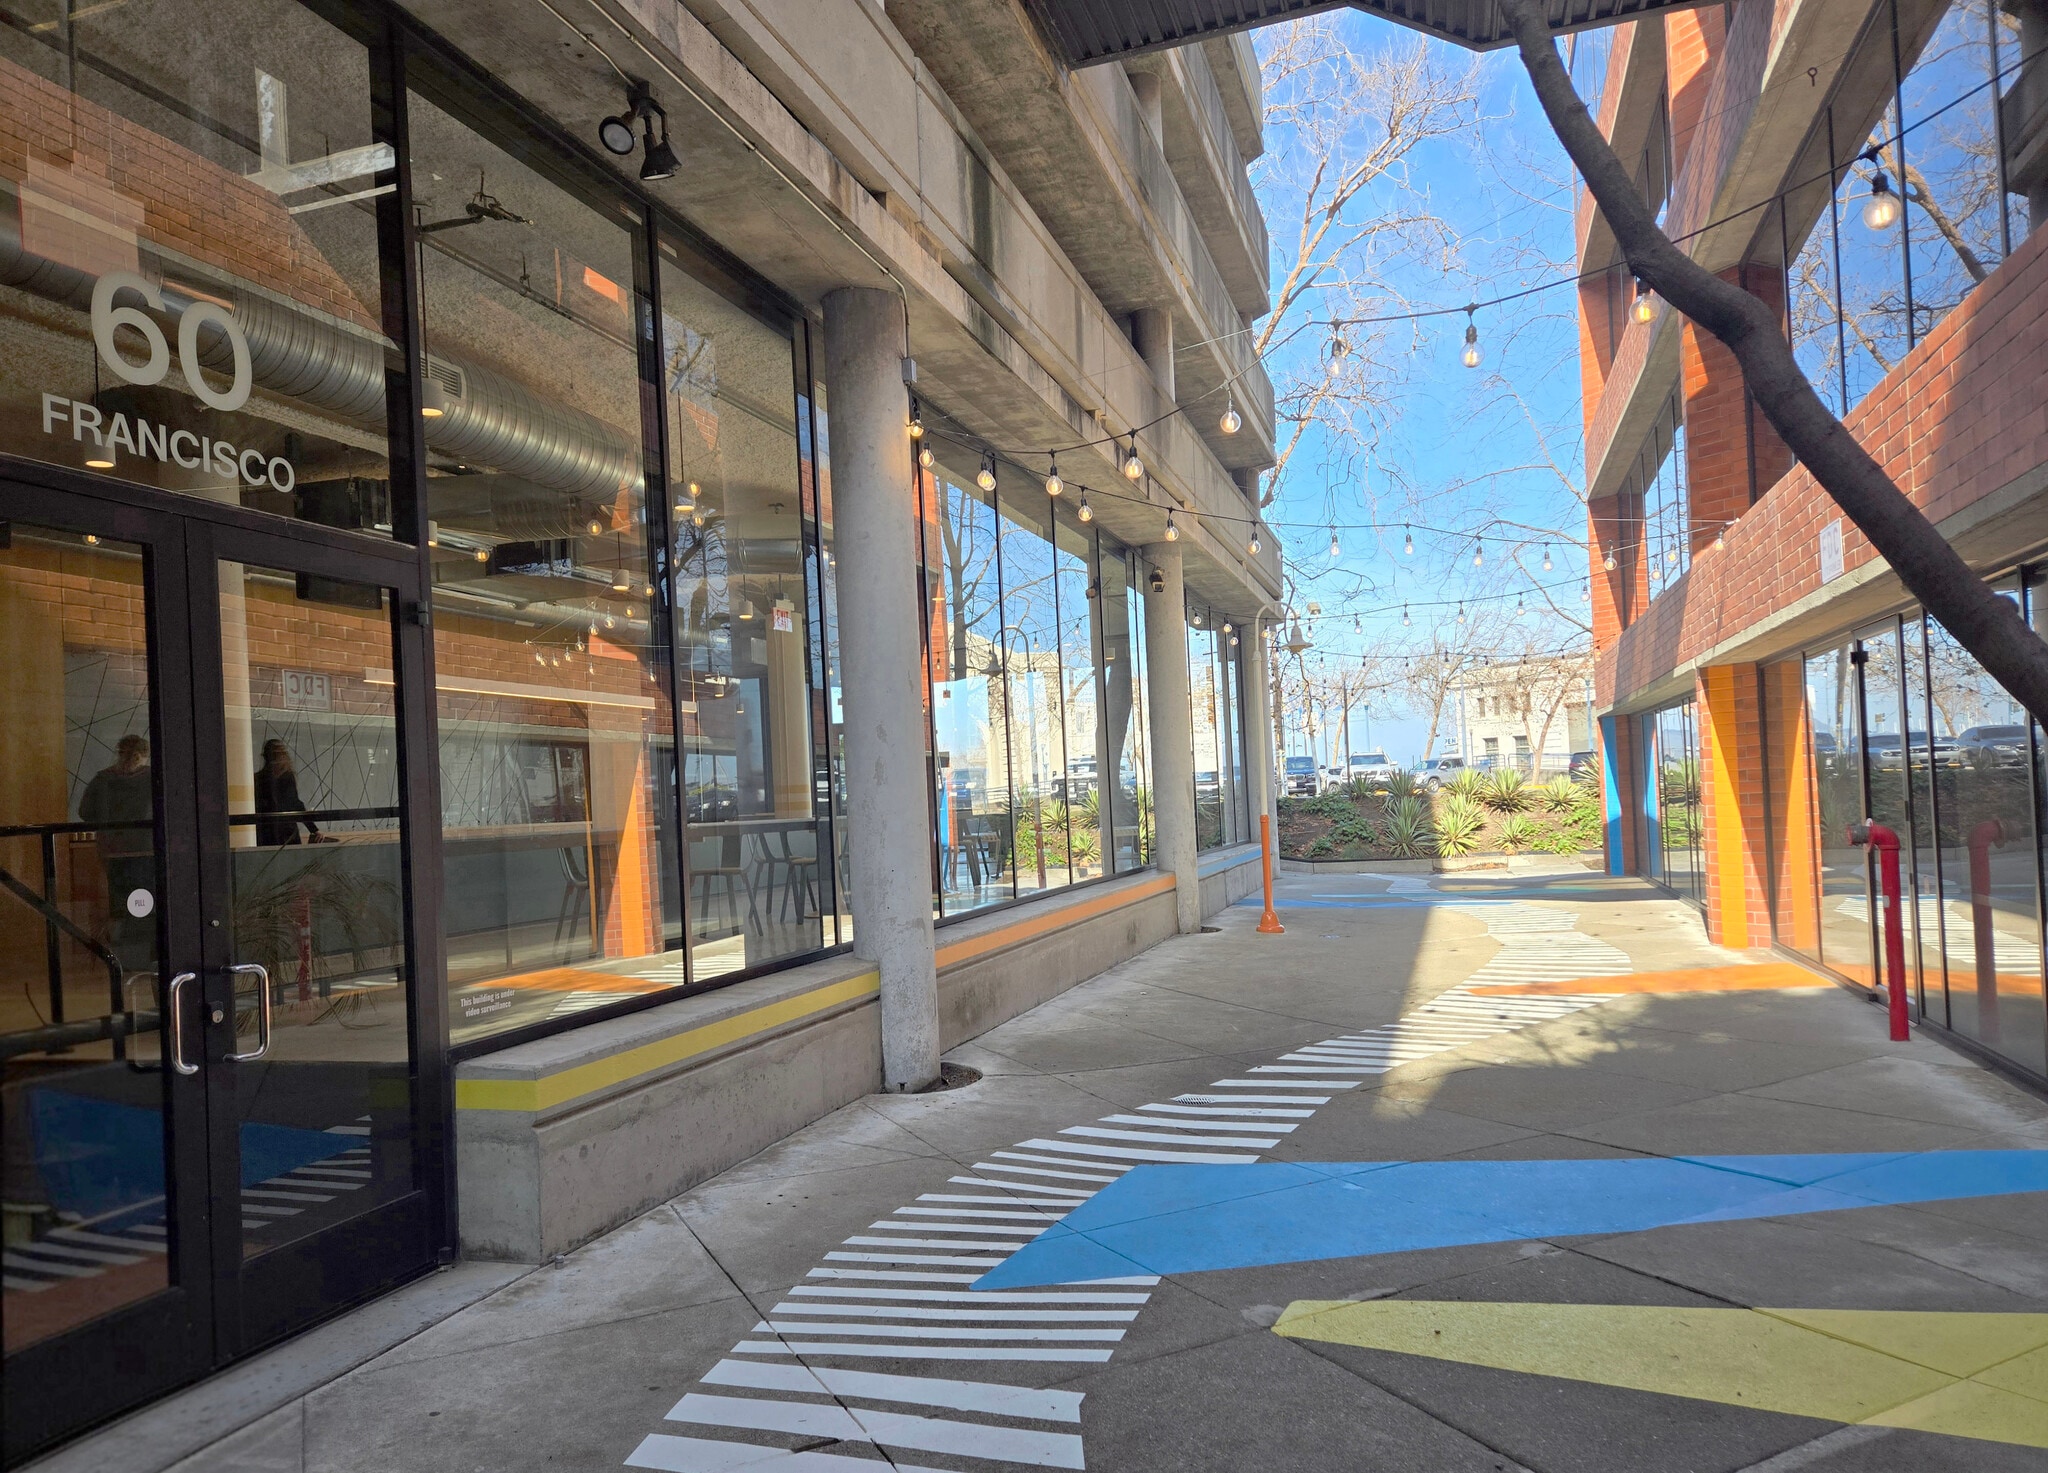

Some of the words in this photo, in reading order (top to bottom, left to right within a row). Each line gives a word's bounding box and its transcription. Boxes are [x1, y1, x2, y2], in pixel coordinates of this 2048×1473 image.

[91, 270, 252, 411] 60
[42, 392, 295, 493] FRANCISCO
[134, 899, 145, 907] PULL
[460, 998, 472, 1007] This
[472, 993, 495, 1005] building
[494, 992, 500, 1000] is
[500, 988, 515, 999] under
[465, 1007, 480, 1018] video
[480, 1001, 512, 1014] surveillance
